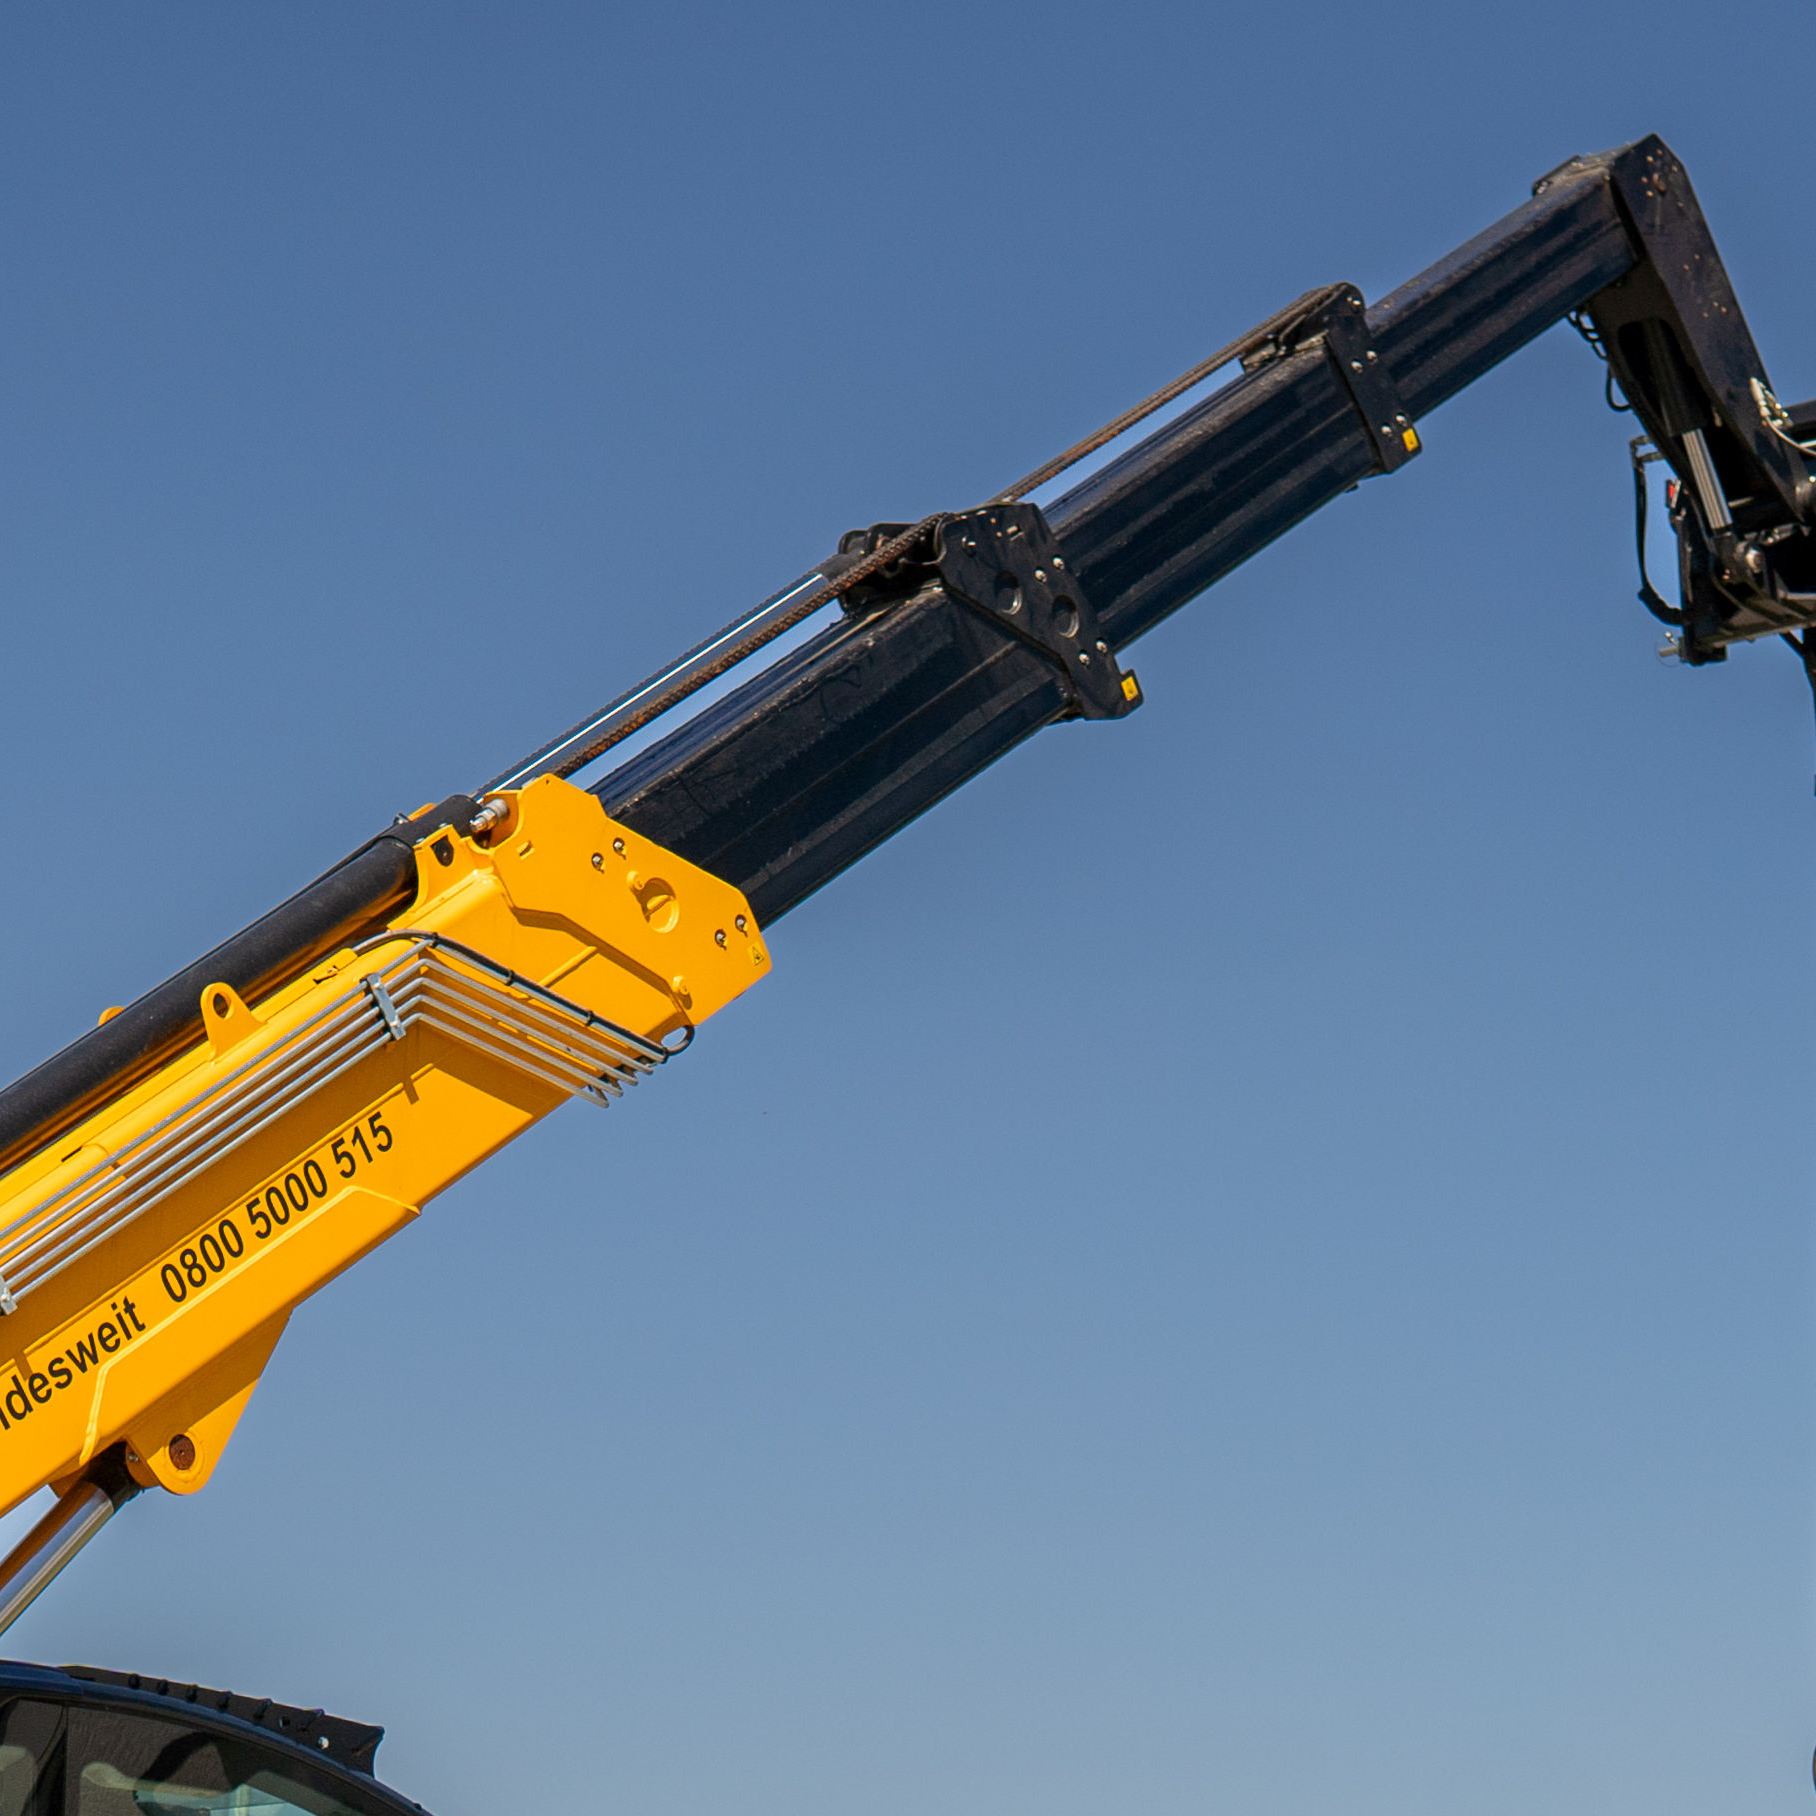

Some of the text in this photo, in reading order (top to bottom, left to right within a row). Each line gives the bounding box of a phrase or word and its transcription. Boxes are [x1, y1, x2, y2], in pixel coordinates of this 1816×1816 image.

[160, 1219, 244, 1303] 0800
[245, 1159, 328, 1239] 5000
[330, 1111, 393, 1179] 515
